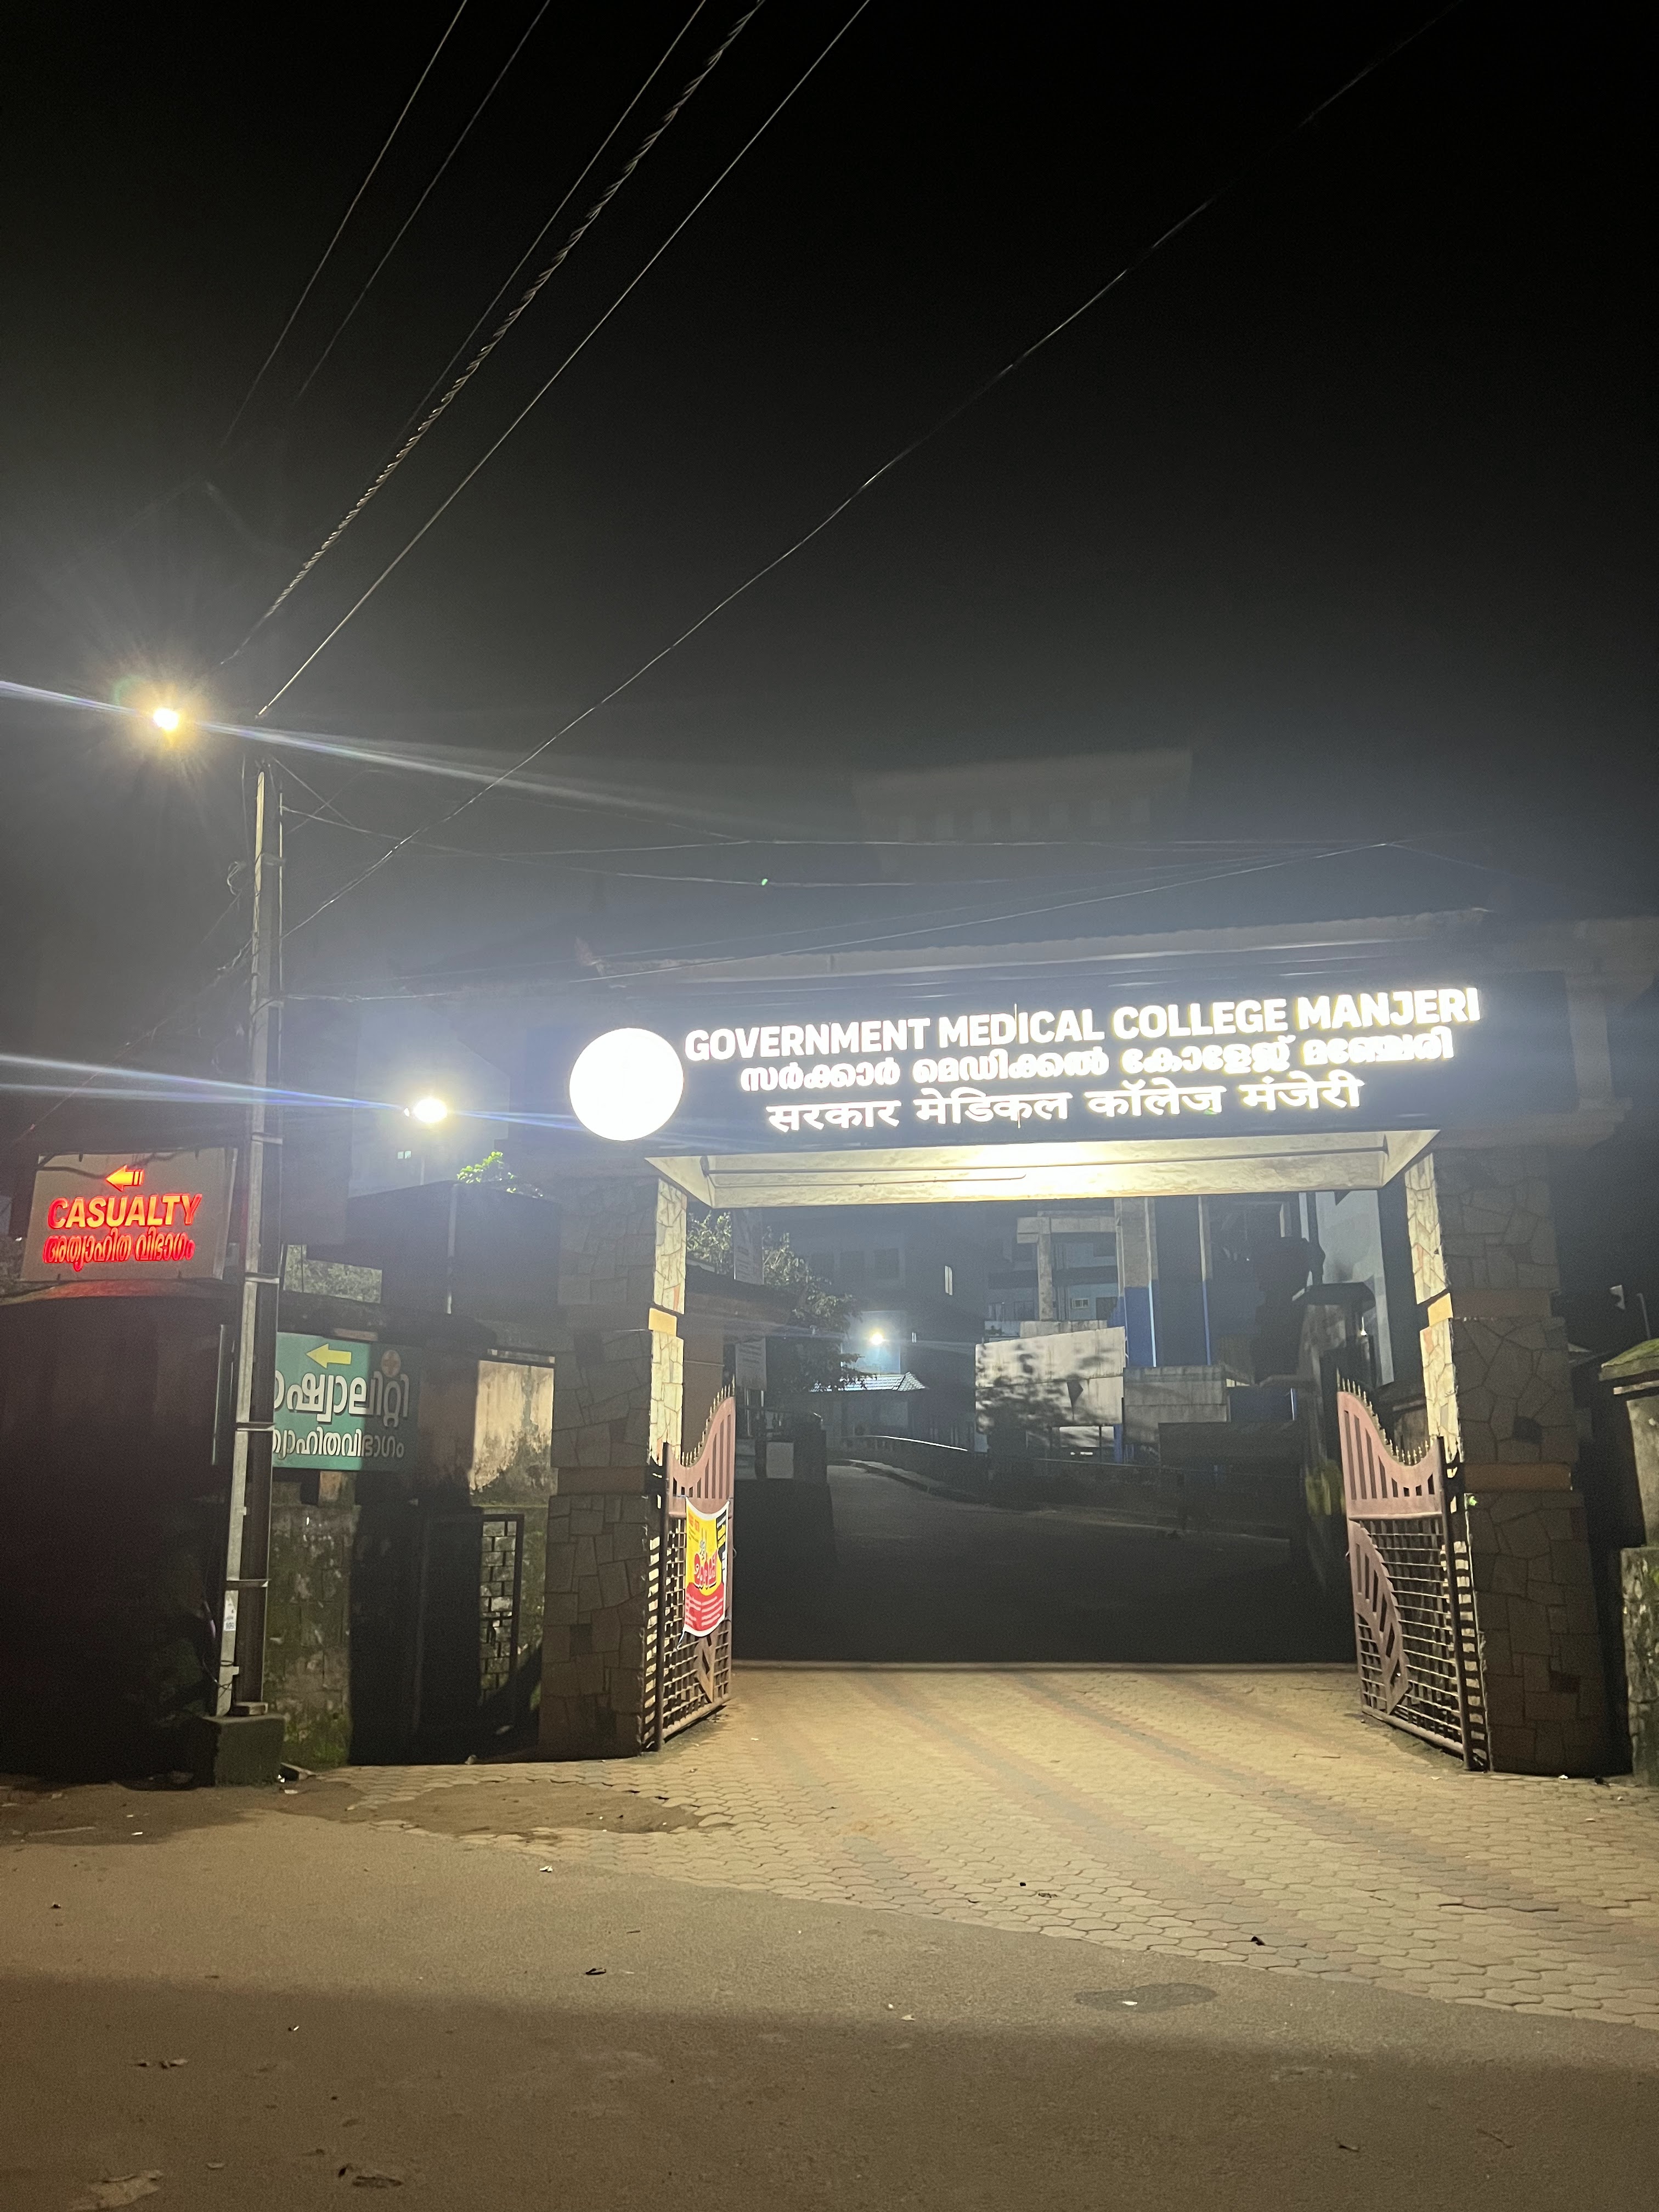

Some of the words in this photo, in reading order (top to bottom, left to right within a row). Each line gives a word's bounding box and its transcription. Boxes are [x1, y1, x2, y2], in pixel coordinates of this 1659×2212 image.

[686, 1018, 931, 1062] GOVERNMENT
[938, 1009, 1105, 1048] MEDICAL
[1113, 998, 1289, 1040] COLLEGE
[1297, 988, 1481, 1031] MANJERI
[741, 1057, 901, 1092] സർക്കാർ
[912, 1048, 1109, 1084] മെഡിക്കൽ
[766, 1100, 902, 1133] सरकार
[912, 1087, 1073, 1124] मेडिकल
[1085, 1077, 1227, 1118] कॉलेज
[1238, 1070, 1365, 1110] मंजेरी
[48, 1194, 202, 1229] CASUALTY
[43, 1227, 132, 1272] അത്യാഹിത
[134, 1227, 195, 1261] വിഭാഗം
[274, 1370, 409, 1427] ാഷ്വാലിറ്റി
